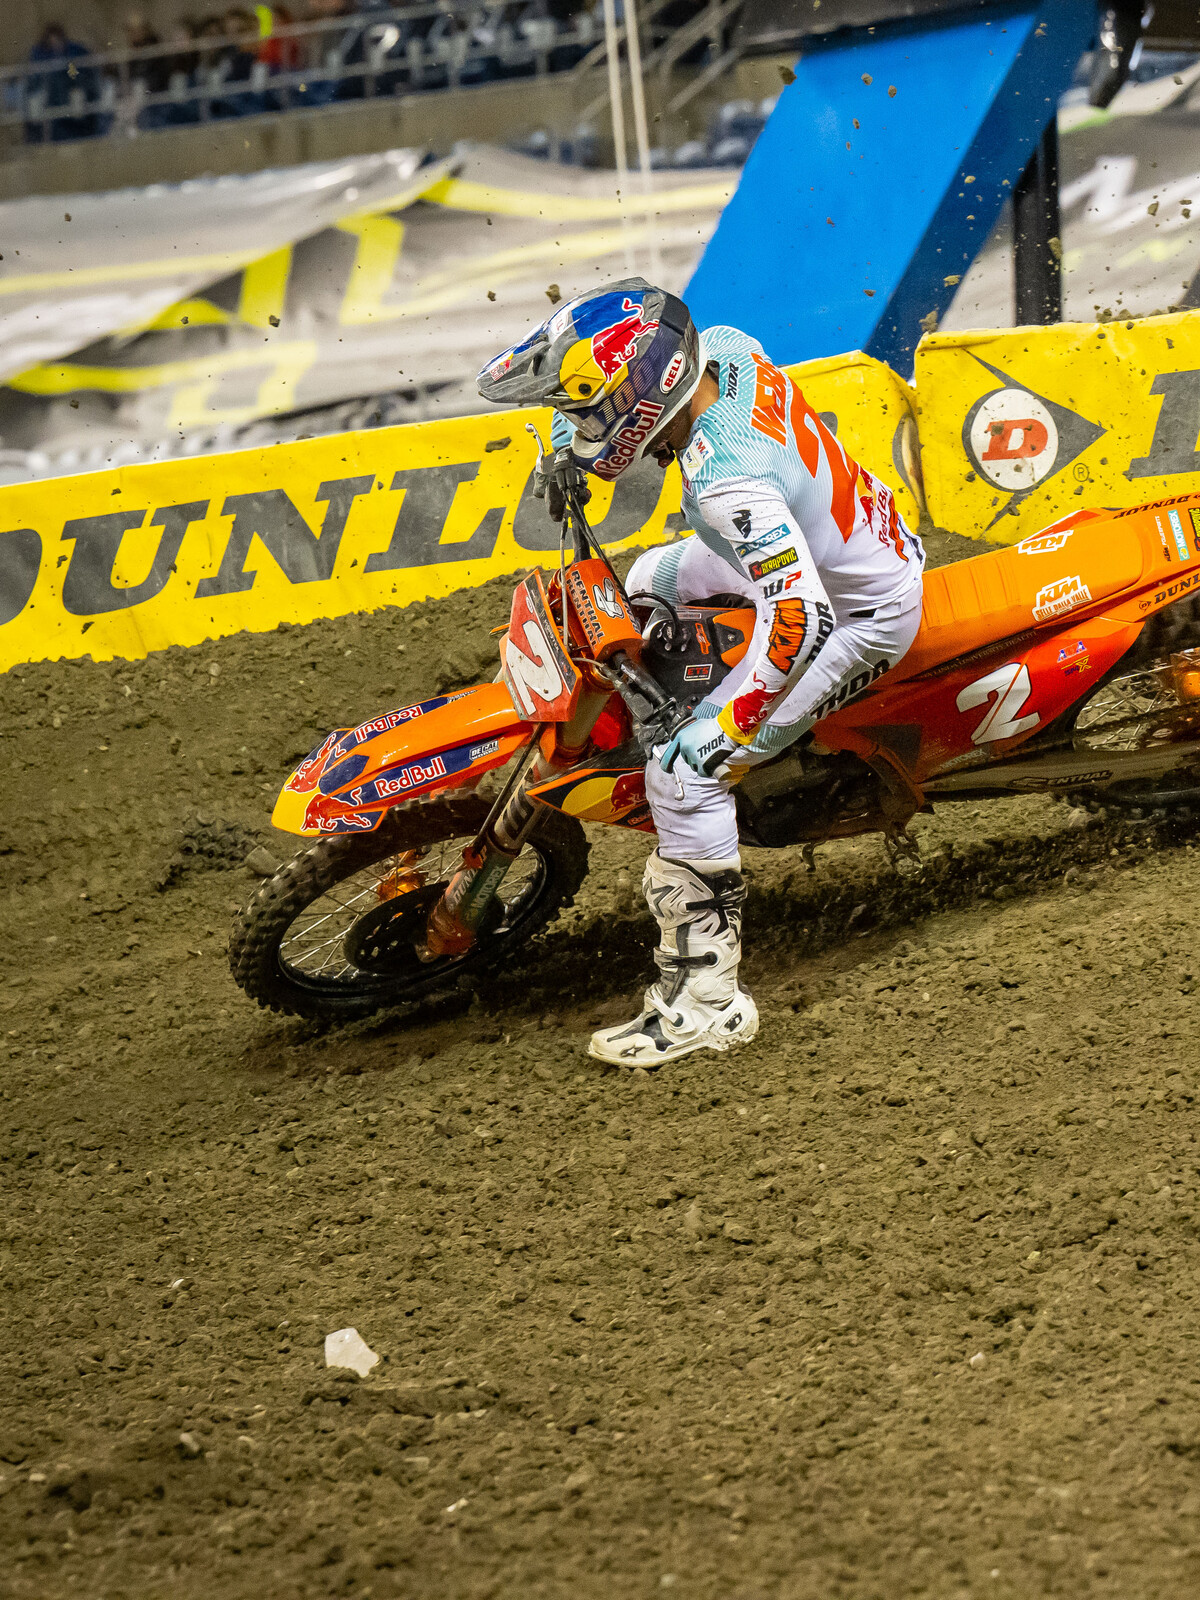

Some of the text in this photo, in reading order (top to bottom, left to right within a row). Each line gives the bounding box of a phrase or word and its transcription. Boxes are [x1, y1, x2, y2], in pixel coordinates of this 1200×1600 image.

[663, 356, 683, 389] BELL
[725, 362, 740, 400] THOR
[593, 400, 665, 482] Red Bull
[982, 418, 1048, 461] D
[0, 411, 837, 626] UNLO
[1169, 511, 1186, 549] MOTOREX
[1018, 530, 1074, 554] KTM
[764, 570, 803, 599] WP
[1036, 575, 1082, 607] KTM
[571, 570, 605, 641] RENTHAL
[1035, 590, 1089, 620] SELLE DALLA VALLE
[804, 601, 834, 664] THOR
[506, 620, 563, 716] 2
[687, 667, 709, 676] ETS
[810, 658, 890, 720] THOR
[955, 662, 1041, 746] 2
[354, 705, 424, 744] Red Bull
[697, 732, 725, 759] THOR
[375, 756, 448, 799] Red Bull
